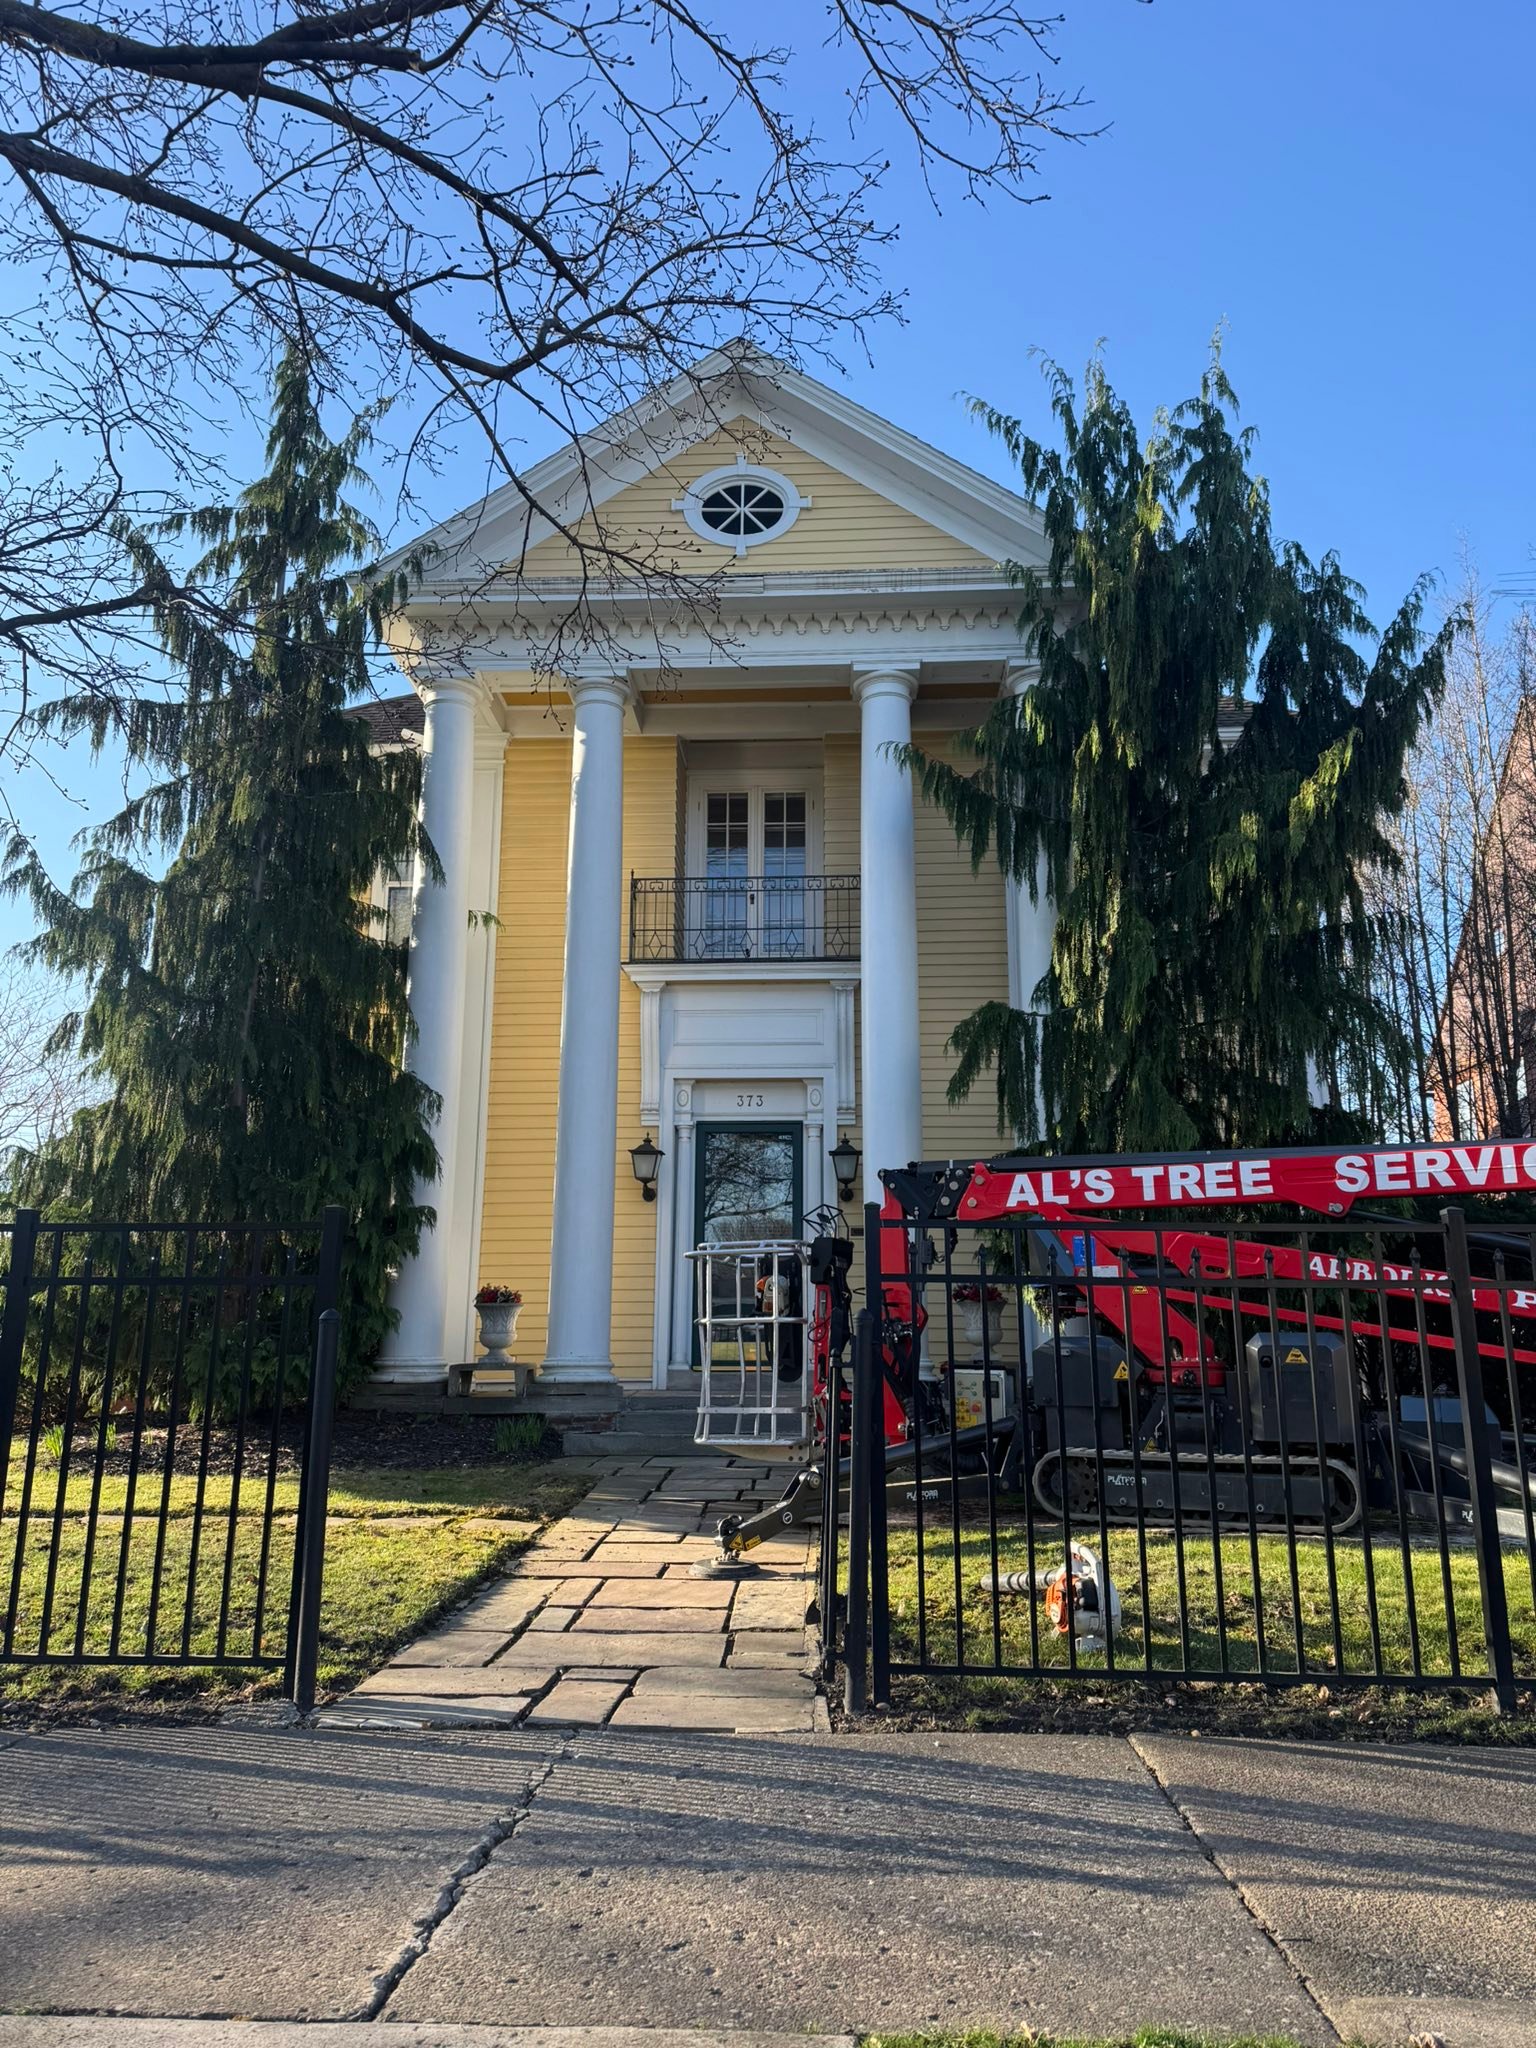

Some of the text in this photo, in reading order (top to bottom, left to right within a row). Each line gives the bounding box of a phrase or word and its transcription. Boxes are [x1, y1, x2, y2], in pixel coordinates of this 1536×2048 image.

[737, 1095, 764, 1107] 373
[1006, 1169, 1115, 1207] AL'S
[1131, 1160, 1274, 1201] TREE
